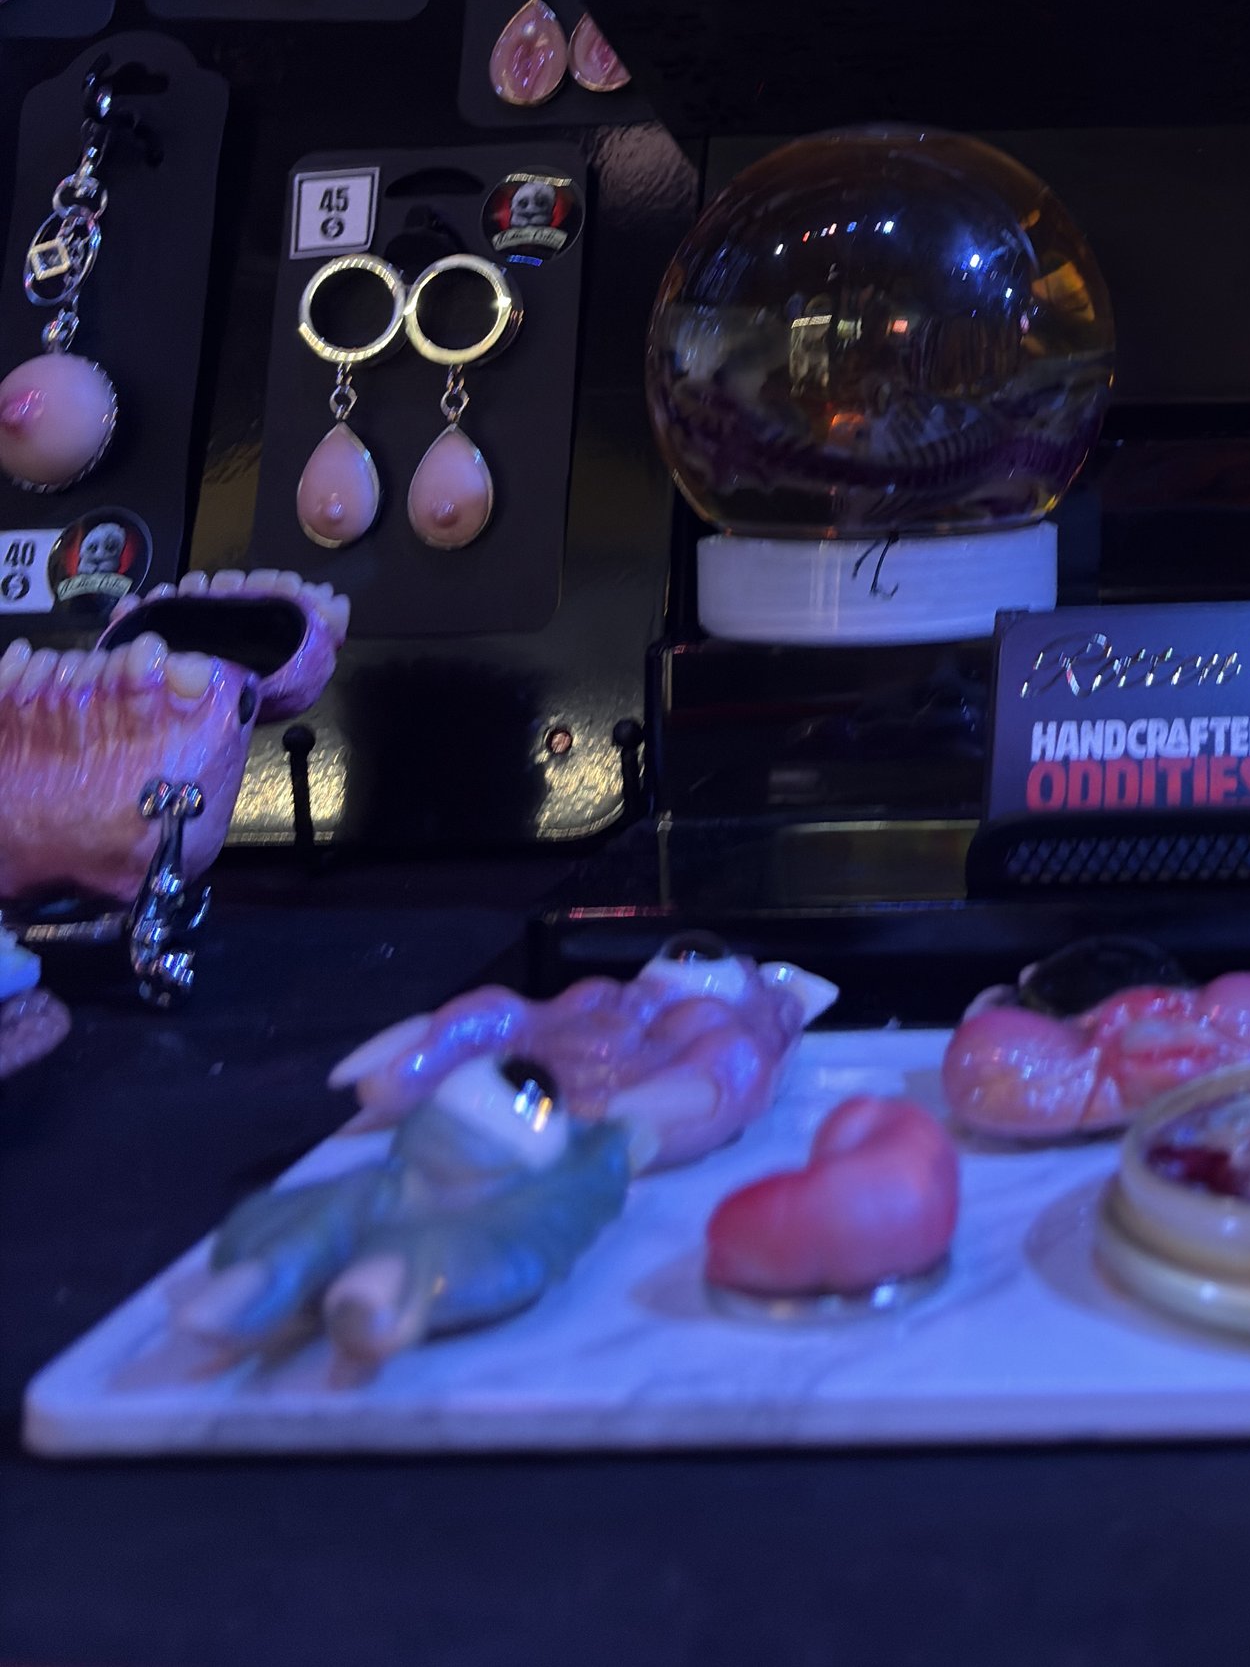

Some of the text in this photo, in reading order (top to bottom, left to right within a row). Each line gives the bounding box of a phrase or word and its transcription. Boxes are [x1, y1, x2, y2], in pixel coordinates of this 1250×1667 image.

[319, 187, 350, 213] 45
[4, 541, 35, 569] 40
[1020, 632, 1241, 698] Rotten
